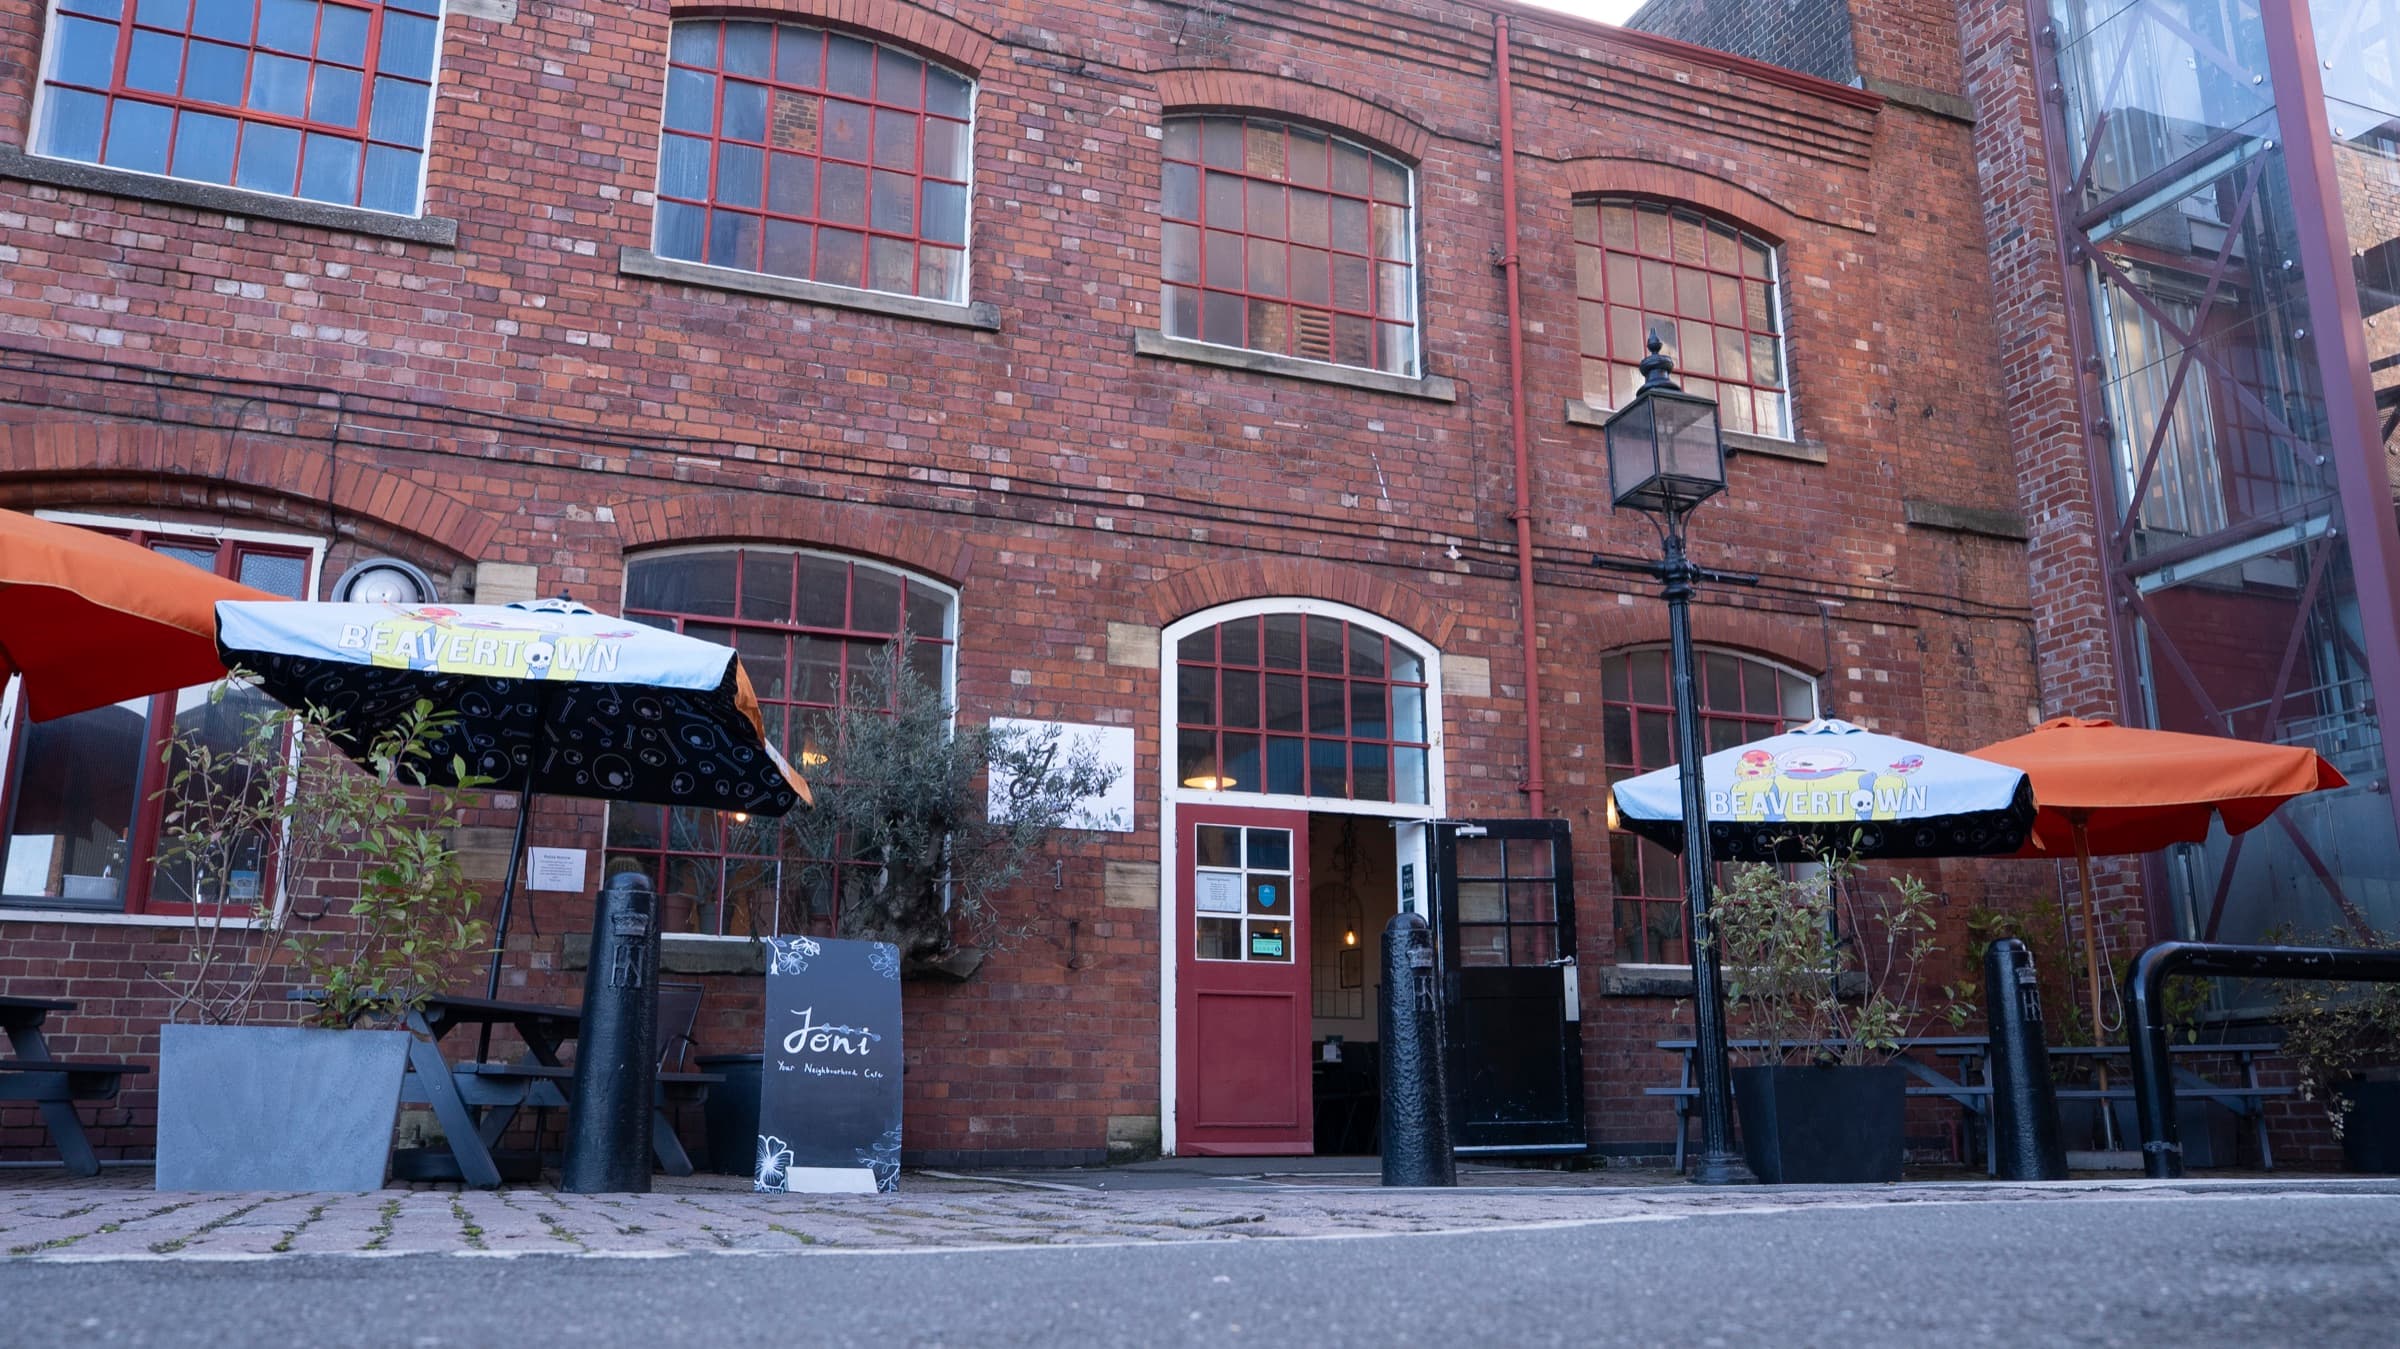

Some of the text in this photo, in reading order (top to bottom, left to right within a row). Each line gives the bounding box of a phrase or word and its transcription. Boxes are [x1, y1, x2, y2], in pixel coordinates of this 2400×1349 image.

[337, 622, 622, 673] BEAVERTOWN
[1709, 785, 1928, 817] BEAVERTOWN
[783, 1006, 871, 1056] Joni
[777, 1059, 795, 1072] Your
[804, 1062, 859, 1077] Neighbourhood
